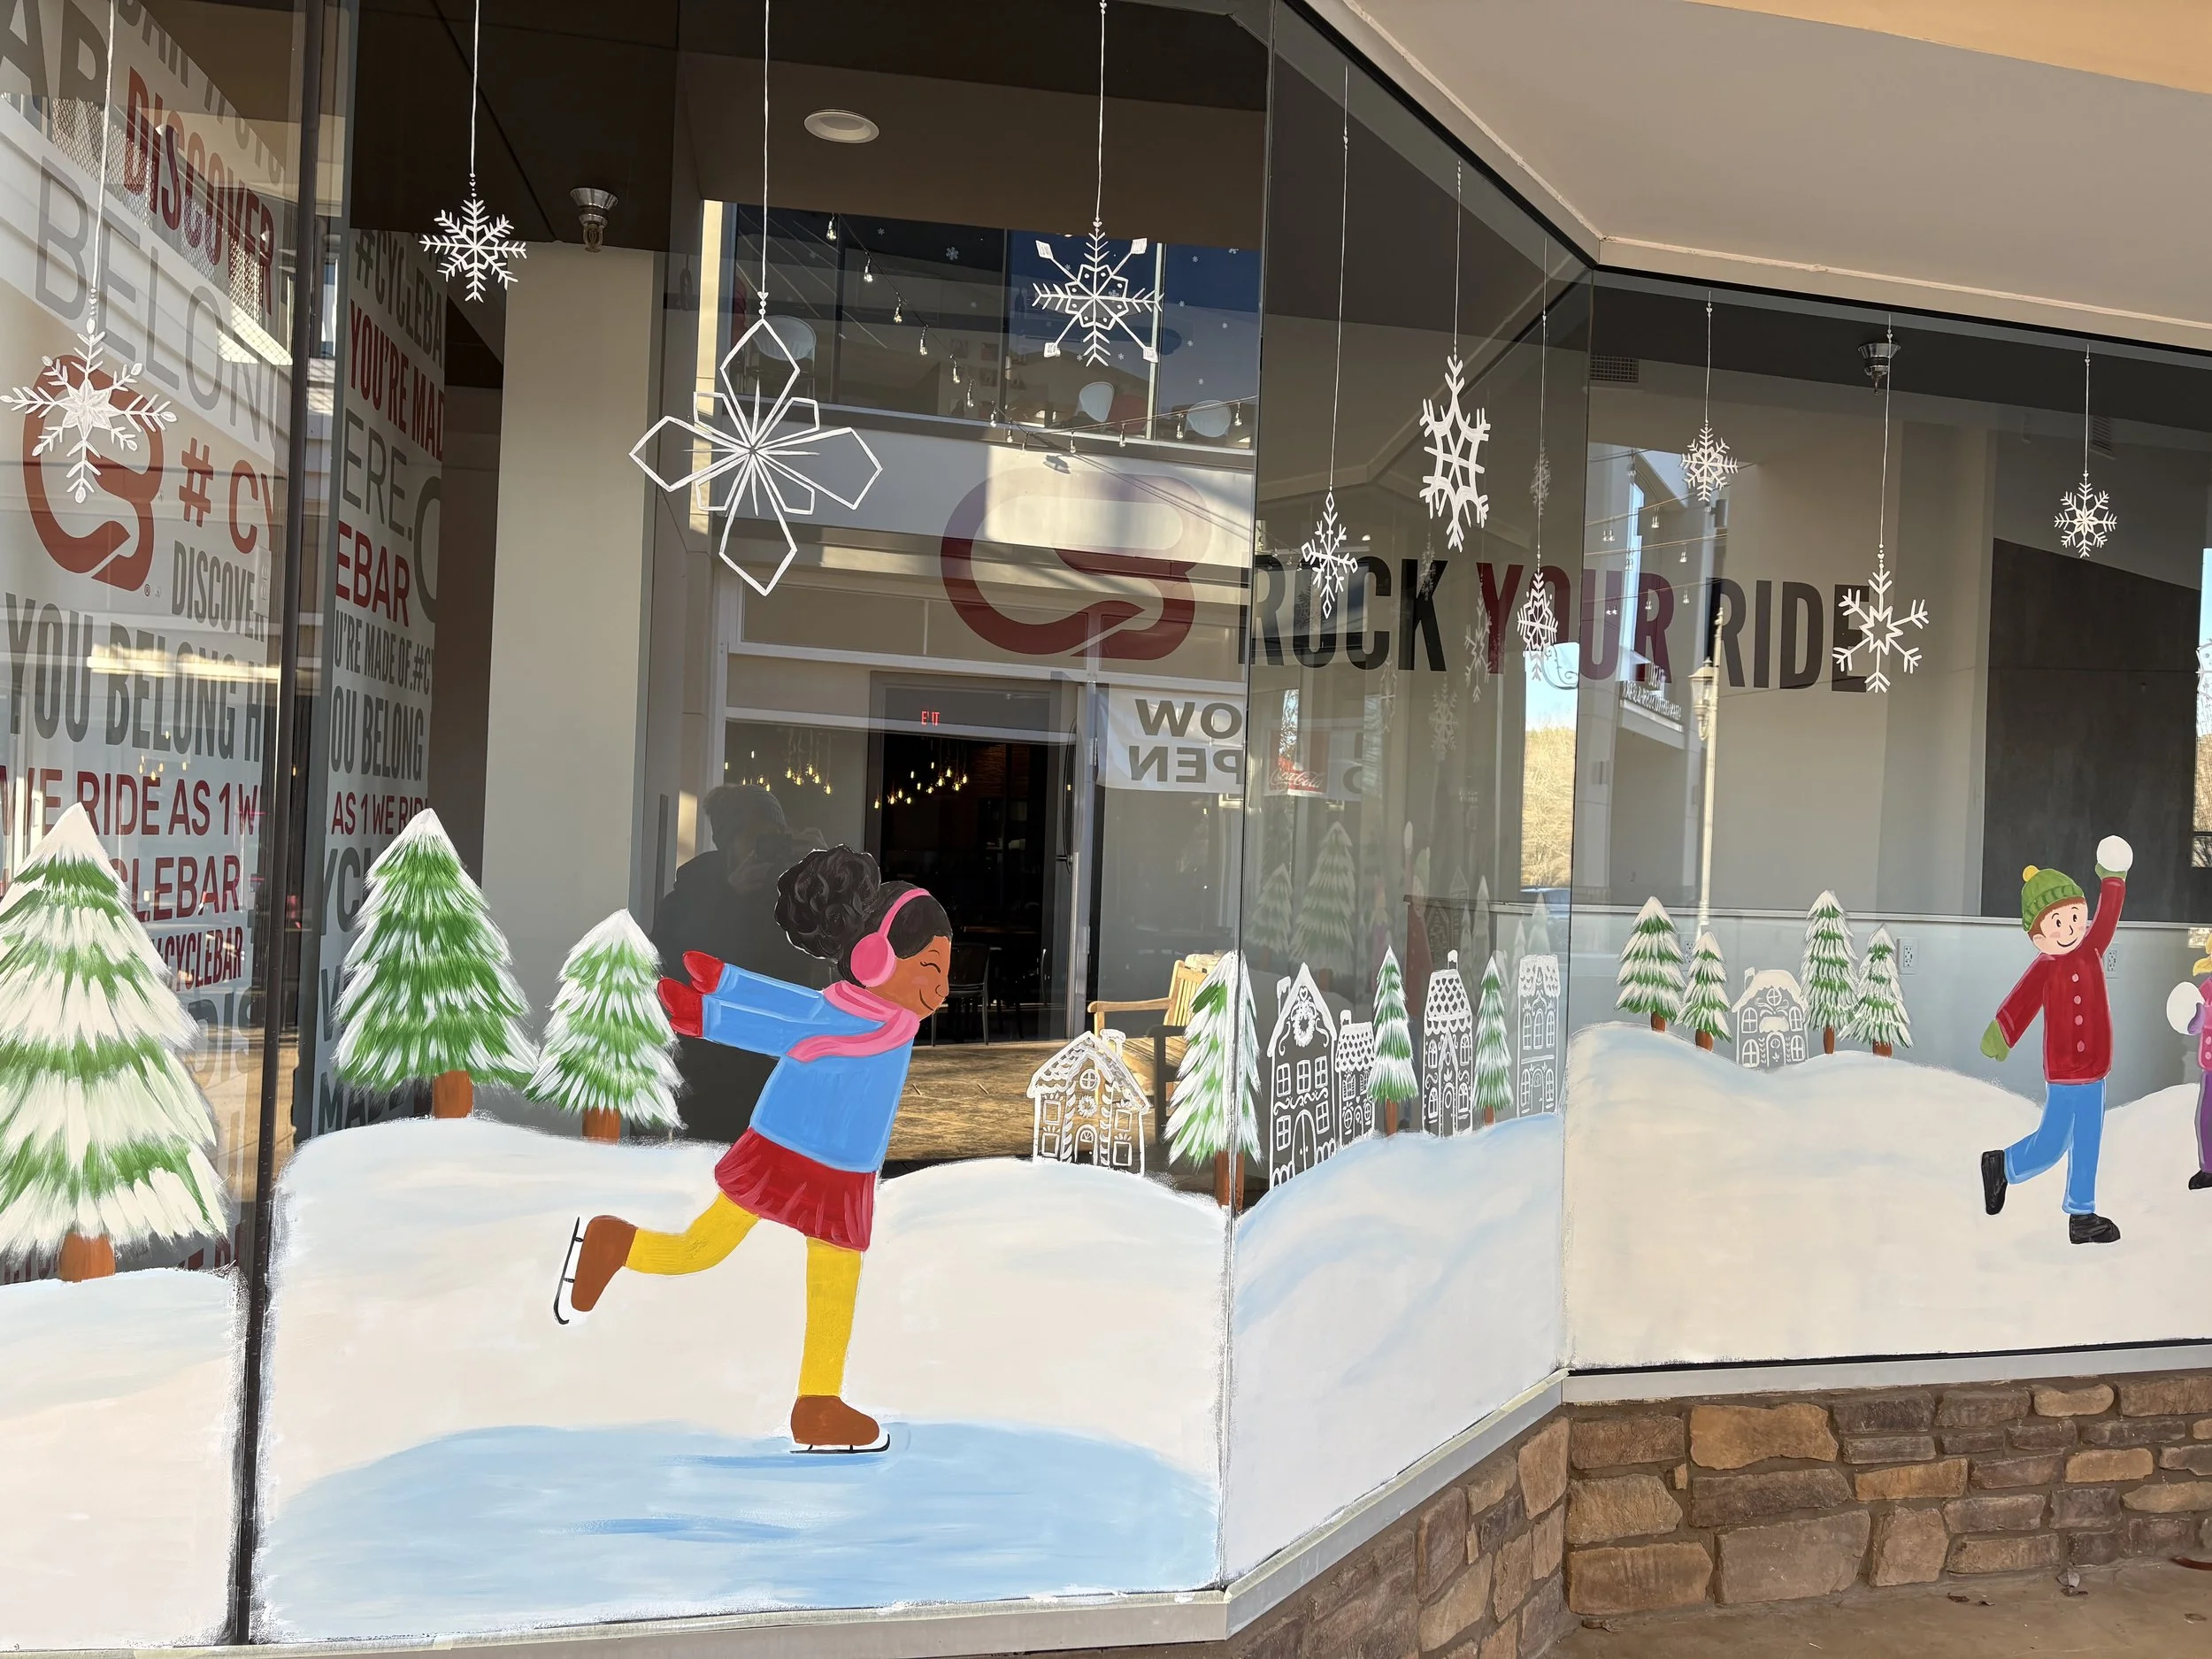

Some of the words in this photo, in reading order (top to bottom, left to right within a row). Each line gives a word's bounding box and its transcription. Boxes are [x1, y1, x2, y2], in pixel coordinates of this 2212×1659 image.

[123, 65, 274, 316] DISCOVER
[349, 299, 409, 434] YOU'RE
[335, 520, 410, 627] EBAR
[365, 622, 396, 685] MADE
[1238, 553, 1448, 672] ROCK
[1476, 562, 1675, 684] YOUR
[1703, 576, 1872, 693] RIDE
[5, 592, 94, 743] YOU
[105, 622, 237, 760] BELONG
[921, 710, 940, 726] EIT
[361, 694, 424, 782] BELONG
[76, 771, 162, 836] RIDE
[168, 779, 211, 836] AS
[219, 782, 231, 836] 1
[331, 791, 357, 835] AS
[360, 794, 368, 834] 1
[372, 795, 395, 835] WE
